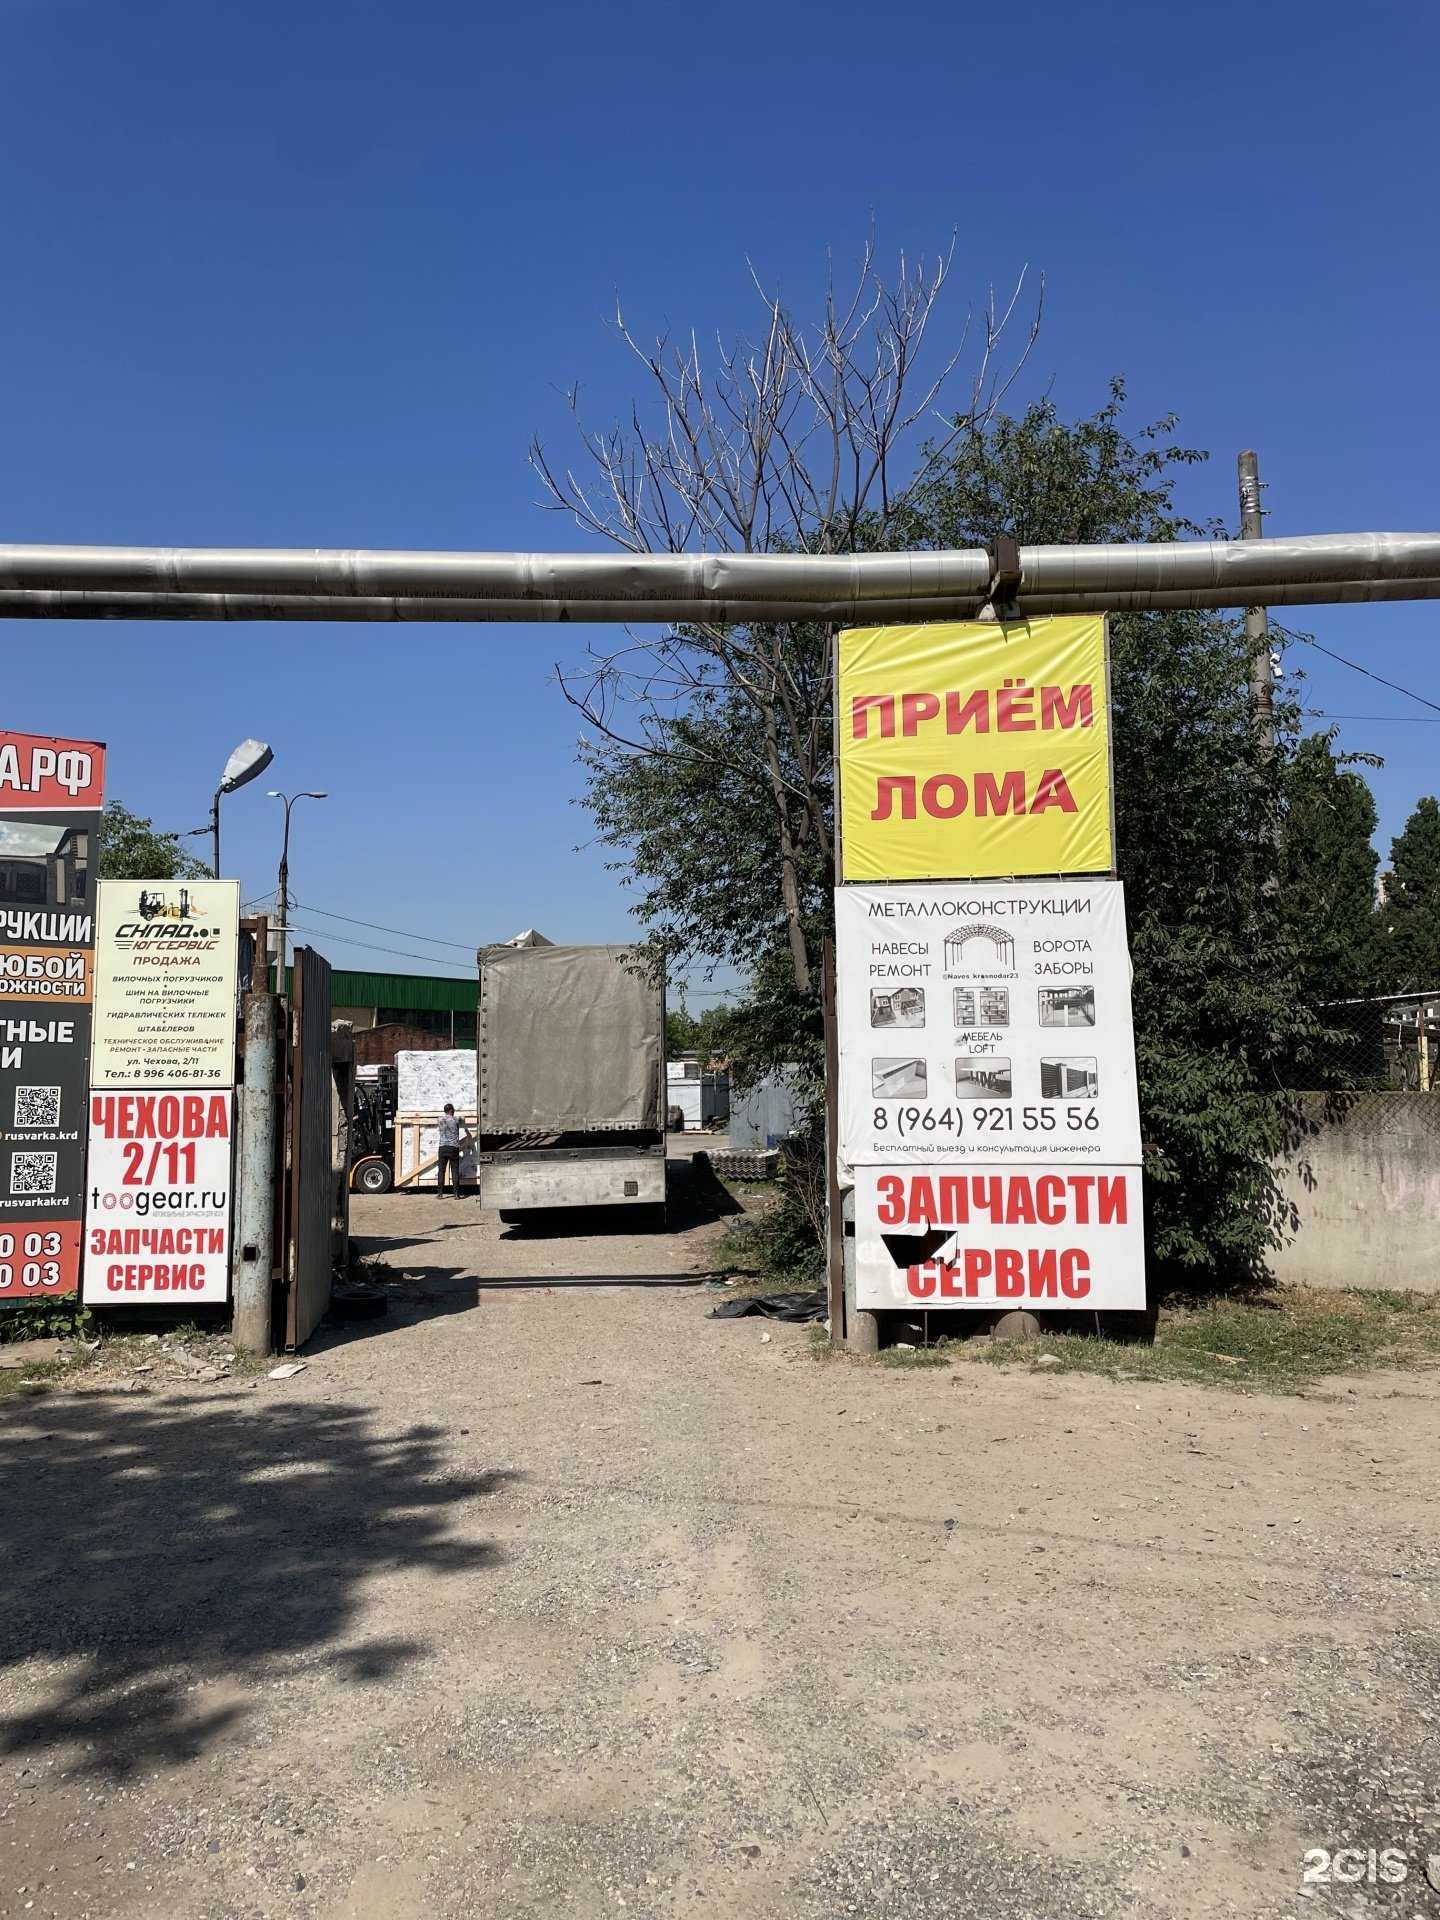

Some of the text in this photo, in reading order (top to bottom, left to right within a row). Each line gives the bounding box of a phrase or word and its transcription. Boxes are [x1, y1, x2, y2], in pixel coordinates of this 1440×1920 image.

[852, 678, 1094, 739] ПРИЁМ
[870, 768, 1079, 821] ЛОМА
[868, 898, 1091, 917] МЕТАЛЛОКОНСТРУКЦИИ
[871, 942, 929, 955] НАВЕСЫ
[1033, 939, 1093, 953] ВОРОТА
[133, 956, 201, 966] ПРОДАЖА
[869, 964, 932, 977] РЕМОНТ
[1034, 962, 1094, 975] ЗАБОРЫ
[961, 1032, 1003, 1042] МЕБЕЛЬ
[968, 1044, 996, 1054] LOFT
[144, 1058, 181, 1066] Чехова,
[183, 1057, 200, 1065] 2/11
[104, 1069, 221, 1078] Тел.: 8 996 406-81-36
[92, 1096, 229, 1139] ЧЕХОВА
[873, 1106, 1100, 1137] 8 (964) 921 55 56
[5, 1131, 78, 1140] rusvarka.krd
[873, 1143, 934, 1153] Бесплатный
[936, 1145, 966, 1154] выезд
[976, 1145, 1048, 1154] консультация
[1050, 1145, 1101, 1153] инженера
[122, 1141, 196, 1185] 2/11
[92, 1187, 226, 1216] toogear.ru
[877, 1175, 1128, 1225] ЗАПЧАСТИ
[24, 1231, 62, 1257] 03
[91, 1228, 224, 1255] ЗАПЧАСТИ
[22, 1261, 60, 1287] 03
[107, 1264, 205, 1291] СЕРВИС
